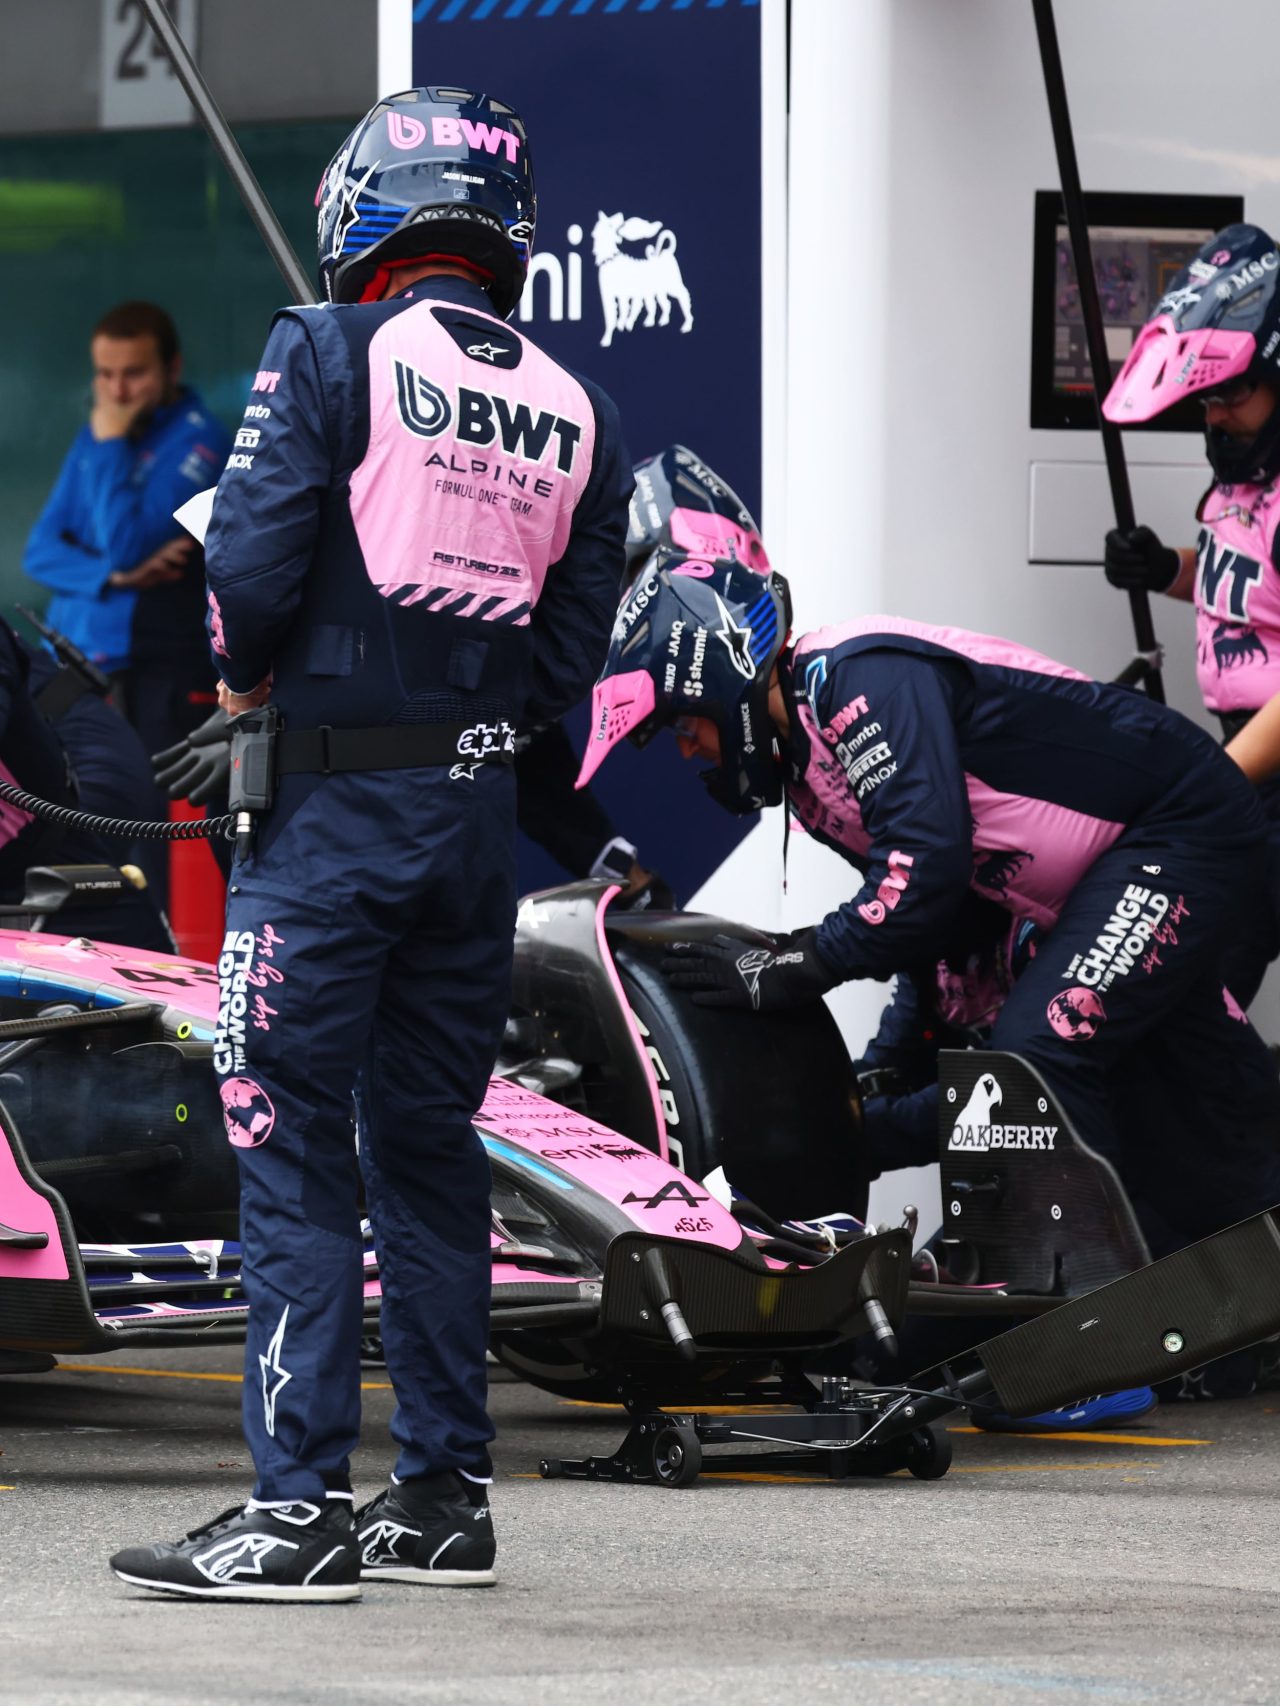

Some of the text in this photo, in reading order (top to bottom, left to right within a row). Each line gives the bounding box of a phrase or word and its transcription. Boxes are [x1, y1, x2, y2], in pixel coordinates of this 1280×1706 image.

[431, 116, 520, 164] BWT
[1231, 252, 1278, 291] MSC
[252, 369, 281, 393] WT
[455, 385, 583, 477] BWT
[424, 452, 554, 498] ALPINE
[623, 576, 659, 627] MSC
[672, 619, 687, 657] JAAQ
[689, 624, 708, 681] shamir
[600, 705, 610, 732] BWT
[740, 701, 754, 743] BINANCE
[829, 694, 869, 735] BWT
[848, 721, 882, 752] mntn
[876, 850, 914, 911] BWT
[1076, 883, 1152, 986] CHANGE
[1096, 892, 1170, 993] THE WORLD
[1141, 894, 1191, 975] sip by sip
[244, 923, 286, 1031] sip by sip
[213, 930, 240, 1076] CHANGE
[228, 930, 256, 1073] THE WORLD
[494, 1111, 583, 1120] Microsoft
[531, 1126, 618, 1138] MSC
[951, 1124, 1058, 1150] OAKBERRY
[540, 1144, 601, 1160] eni
[674, 1216, 714, 1233] A525
